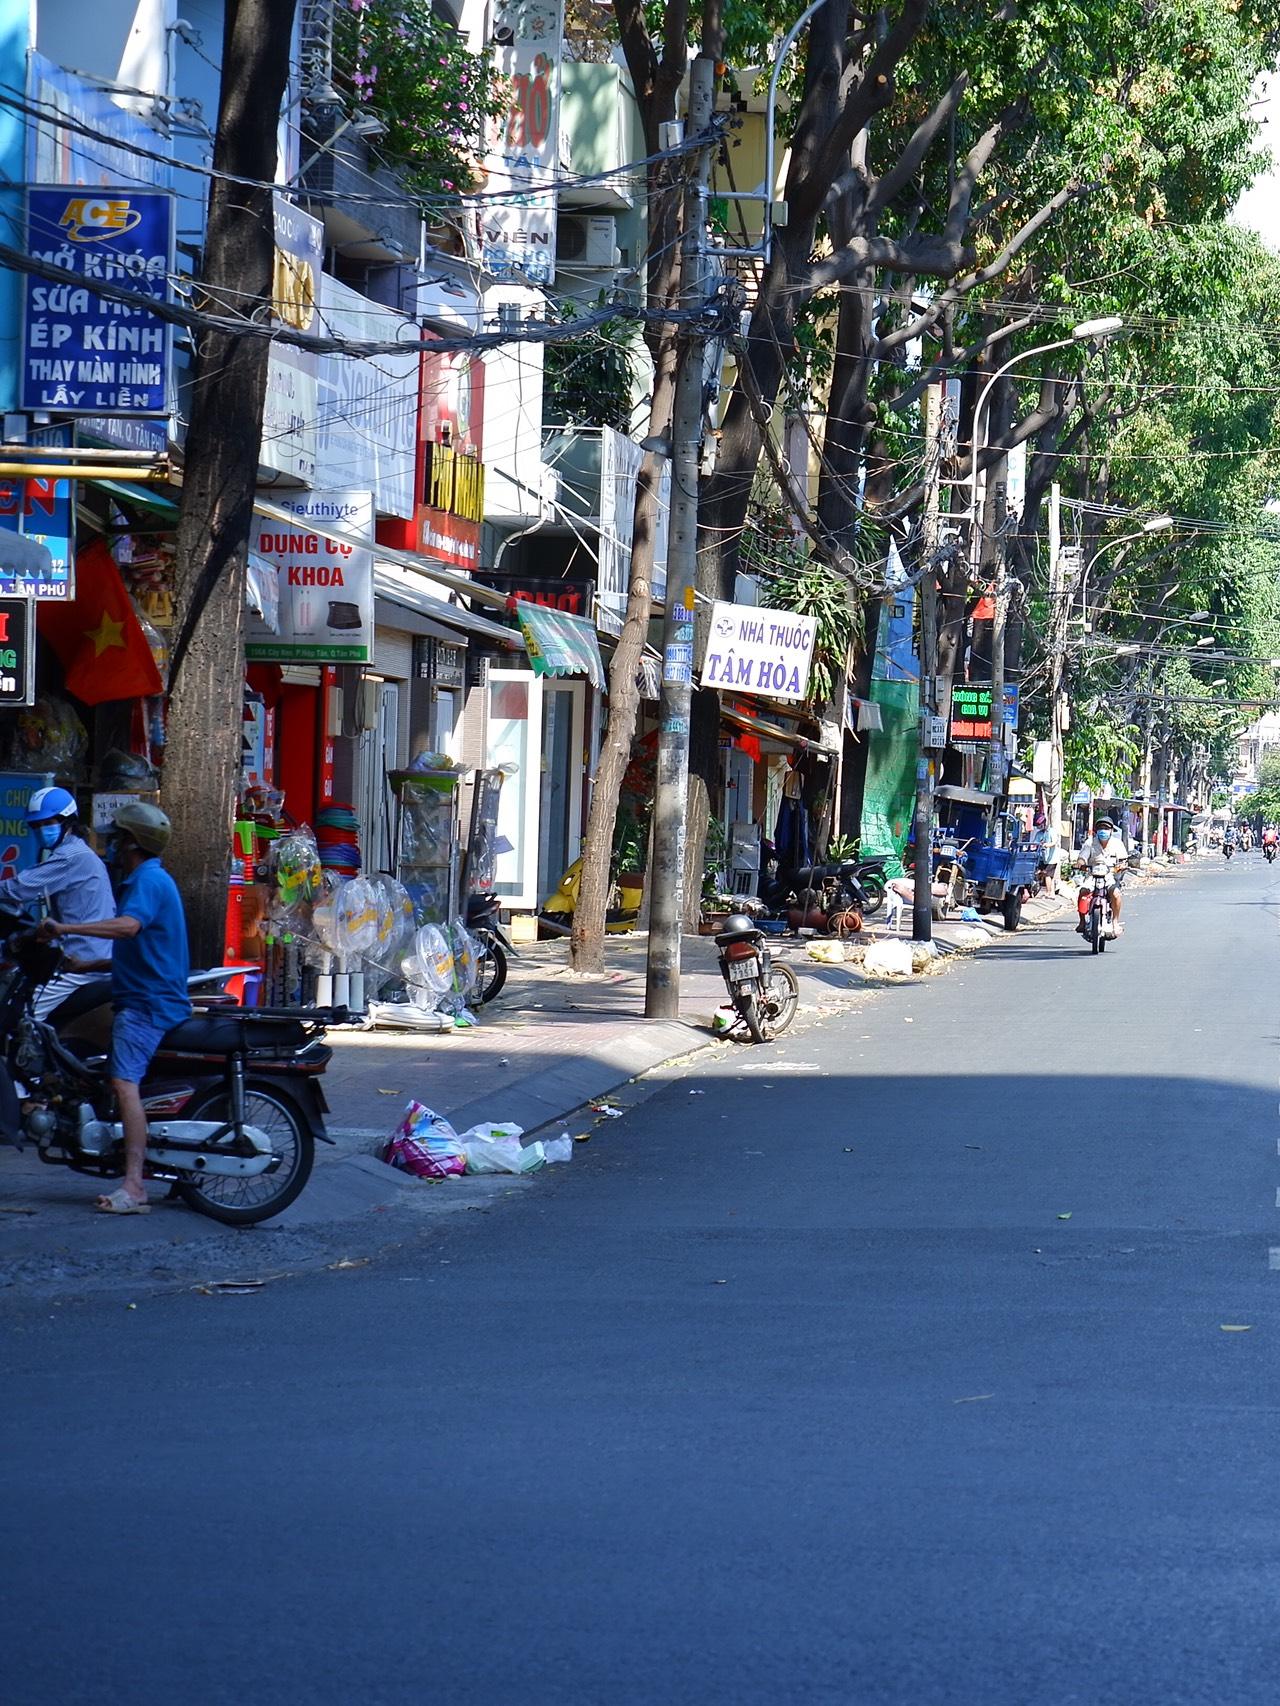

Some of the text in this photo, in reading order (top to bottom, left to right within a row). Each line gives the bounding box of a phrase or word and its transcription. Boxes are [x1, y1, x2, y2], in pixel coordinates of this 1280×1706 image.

[59, 198, 130, 228] ACE
[486, 227, 549, 245] VIÊN
[84, 249, 166, 281] KHÓA
[30, 318, 163, 355] ÉP KÍNH
[29, 355, 161, 385] THAY MÀN HÌNH
[41, 384, 149, 408] LẤY LIỀN
[281, 501, 359, 519] Sieuthiyte
[259, 534, 318, 558] DỤNG
[39, 581, 66, 597] PHÚ
[287, 566, 344, 586] KHOA
[739, 616, 811, 651] NHÀ THUỐC
[709, 647, 754, 686] TÂM
[757, 655, 800, 694] HÒA
